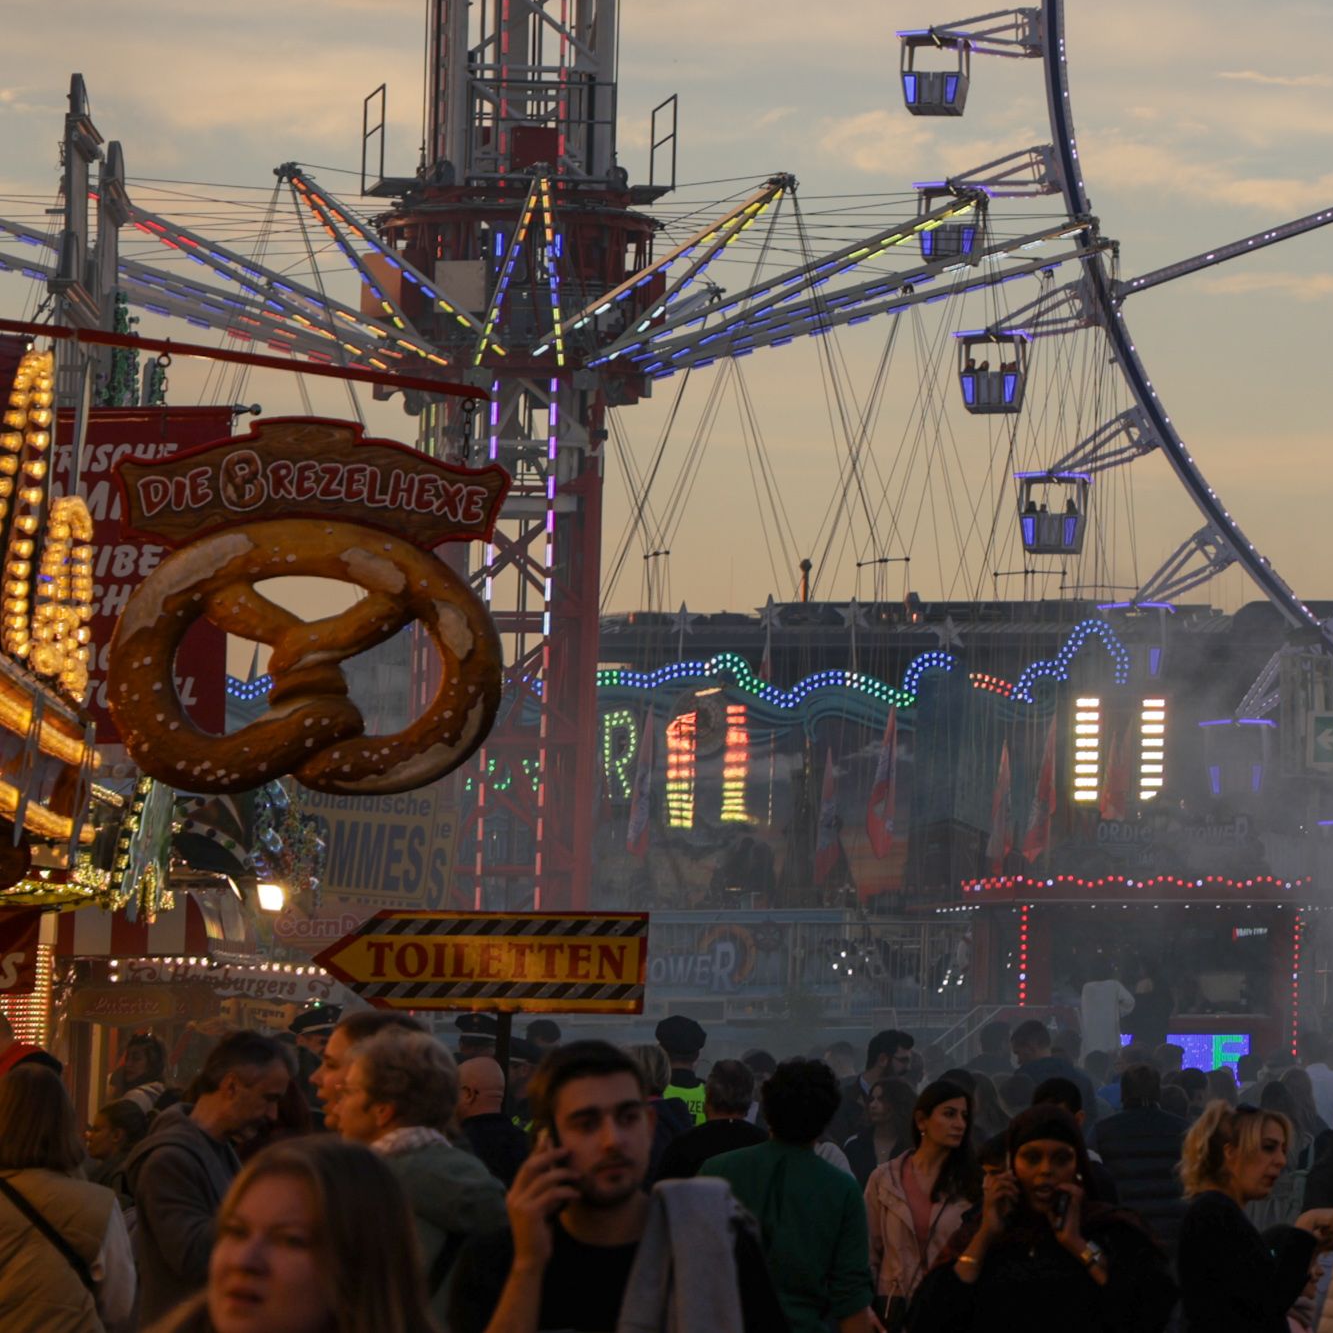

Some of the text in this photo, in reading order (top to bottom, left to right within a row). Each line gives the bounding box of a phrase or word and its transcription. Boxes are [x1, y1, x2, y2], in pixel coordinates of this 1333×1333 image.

[138, 467, 212, 515] DIE
[219, 449, 488, 524] BREZELHEXE
[274, 915, 359, 938] CornD
[366, 940, 627, 982] TOILETTEN
[646, 940, 778, 994] OWER
